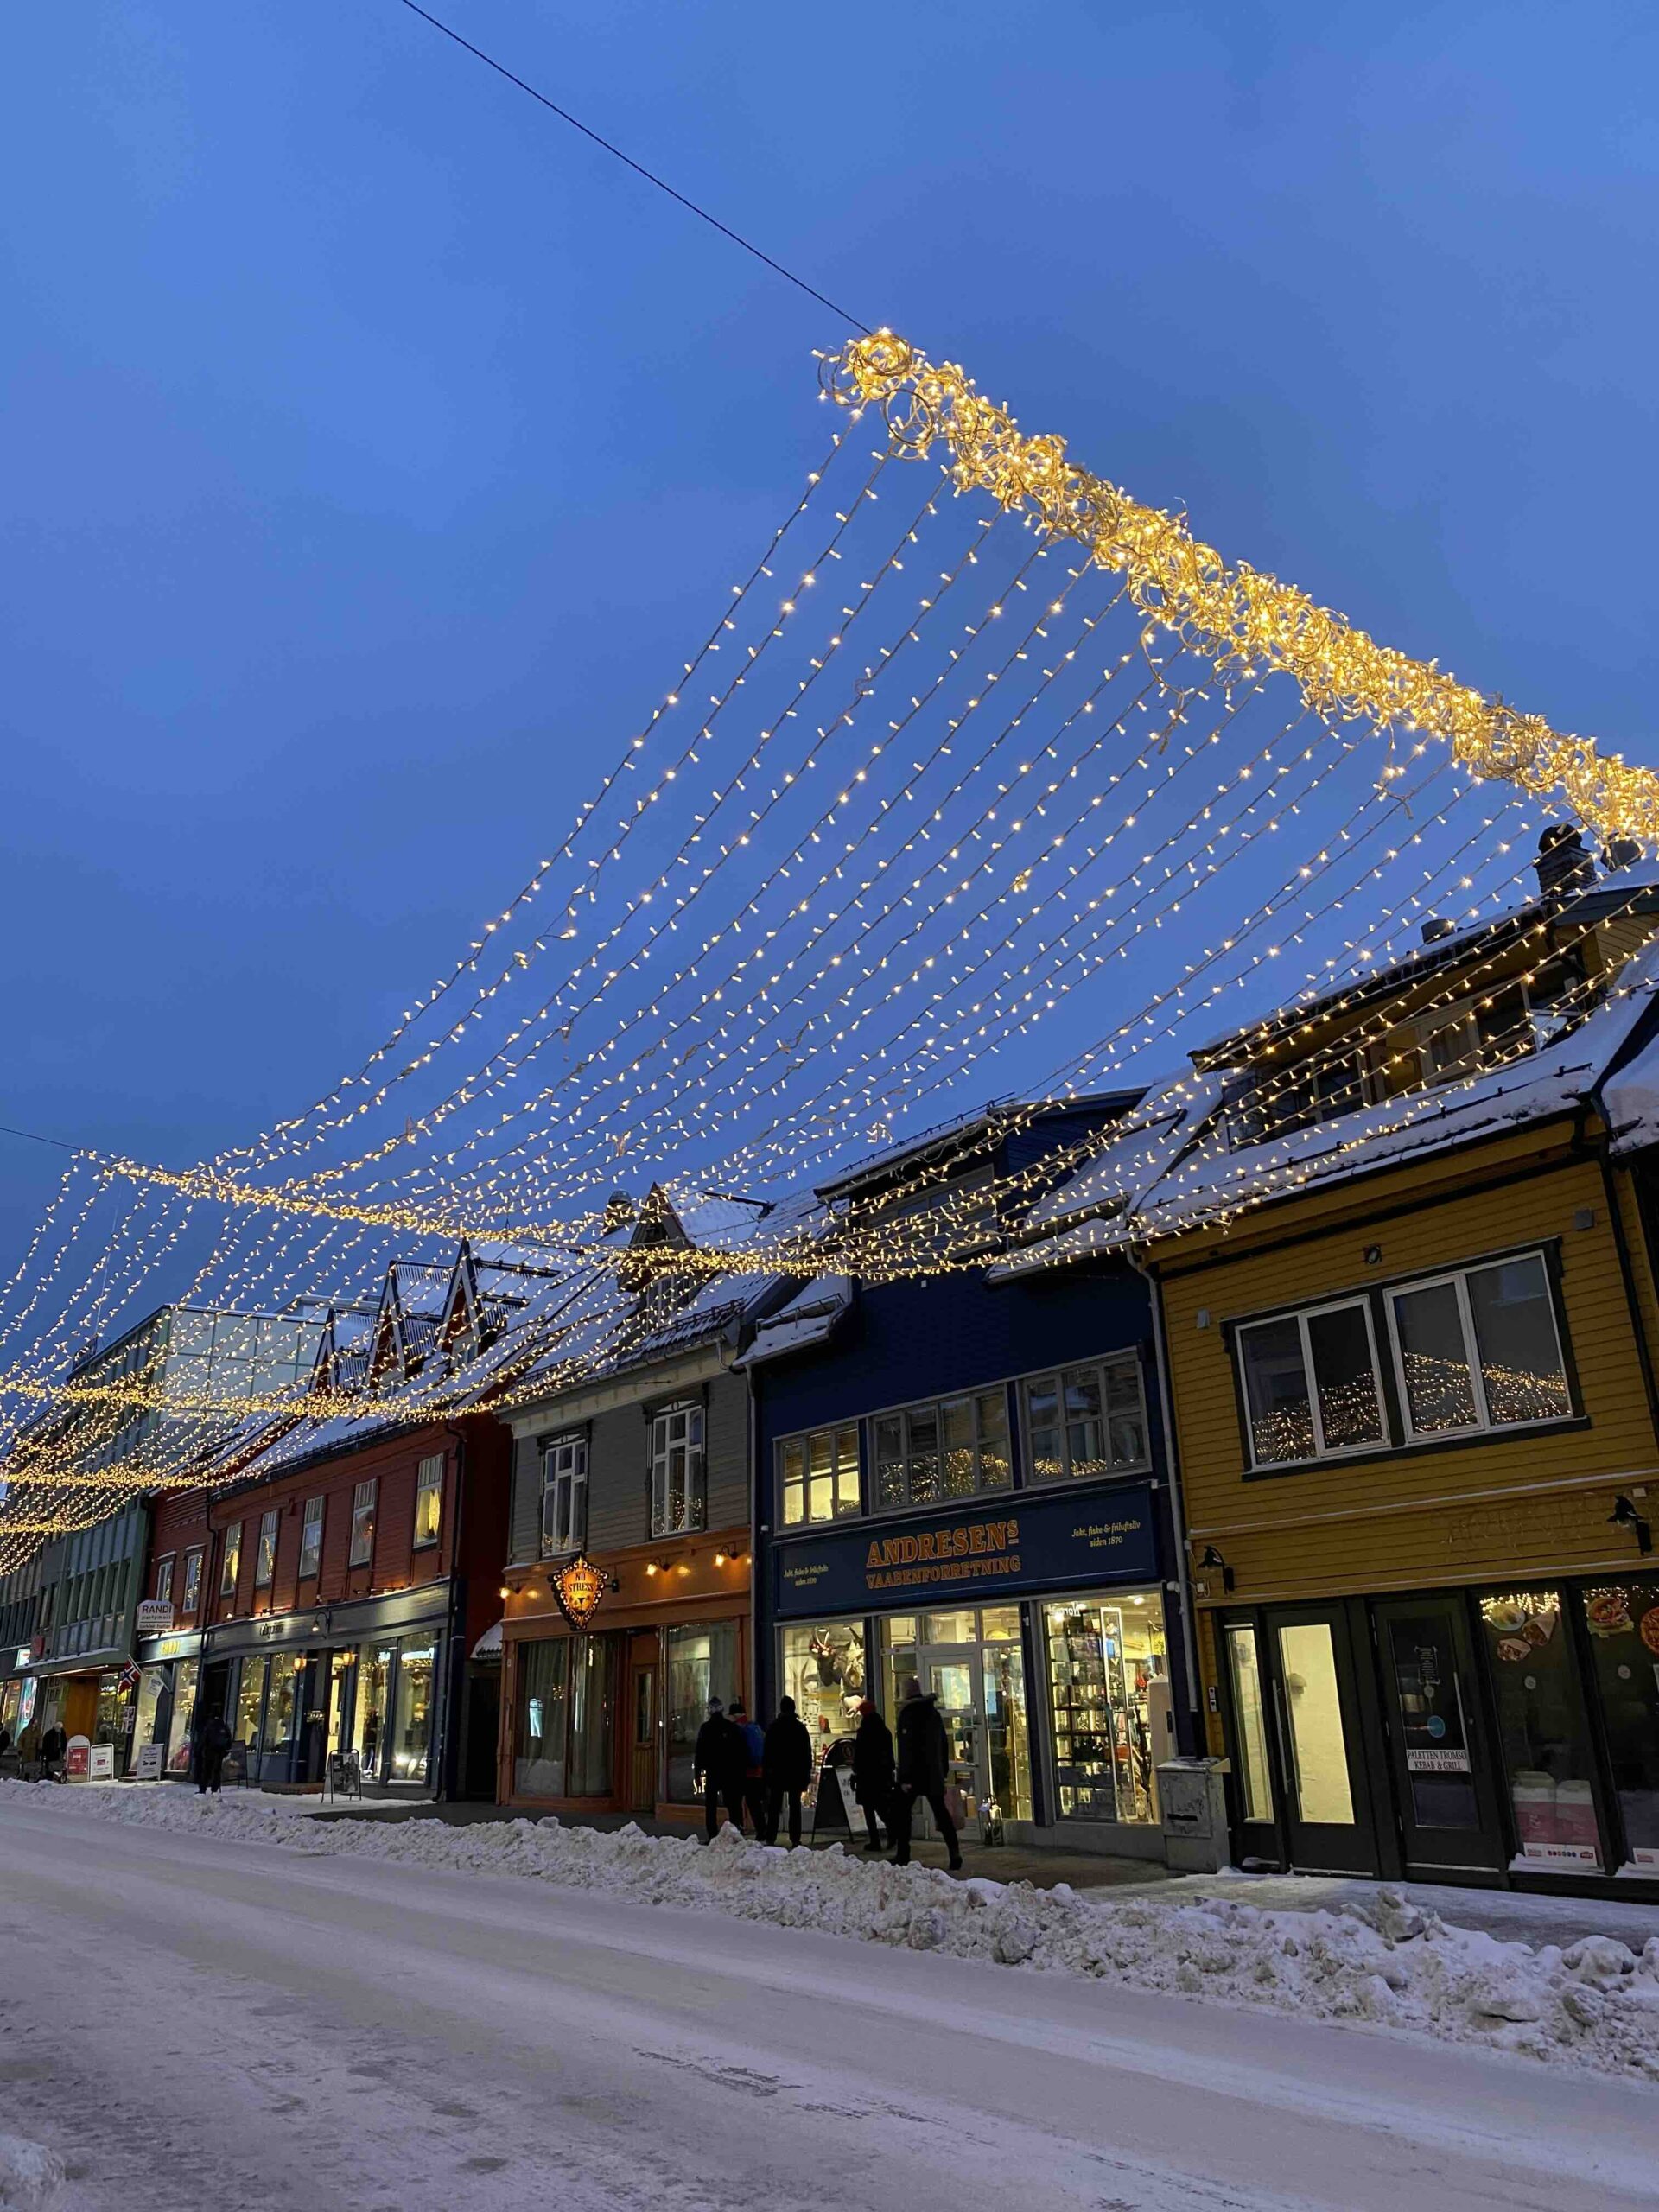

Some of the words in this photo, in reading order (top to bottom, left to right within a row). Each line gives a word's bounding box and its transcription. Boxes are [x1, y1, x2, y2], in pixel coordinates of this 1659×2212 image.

[1089, 1525, 1103, 1537] fiske
[1111, 1520, 1141, 1535] friluftsliv
[1090, 1537, 1107, 1548] siden
[1108, 1535, 1123, 1545] 1870
[575, 1573, 586, 1581] NO
[866, 1555, 1021, 1589] VAABENFORRETNING
[568, 1582, 594, 1592] STRESS
[142, 1605, 172, 1614] RANDI
[1408, 1751, 1439, 1760] PALETTEN
[1414, 1760, 1435, 1770] KEBAB
[1437, 1760, 1443, 1770] &
[1443, 1760, 1463, 1770] GRILL
